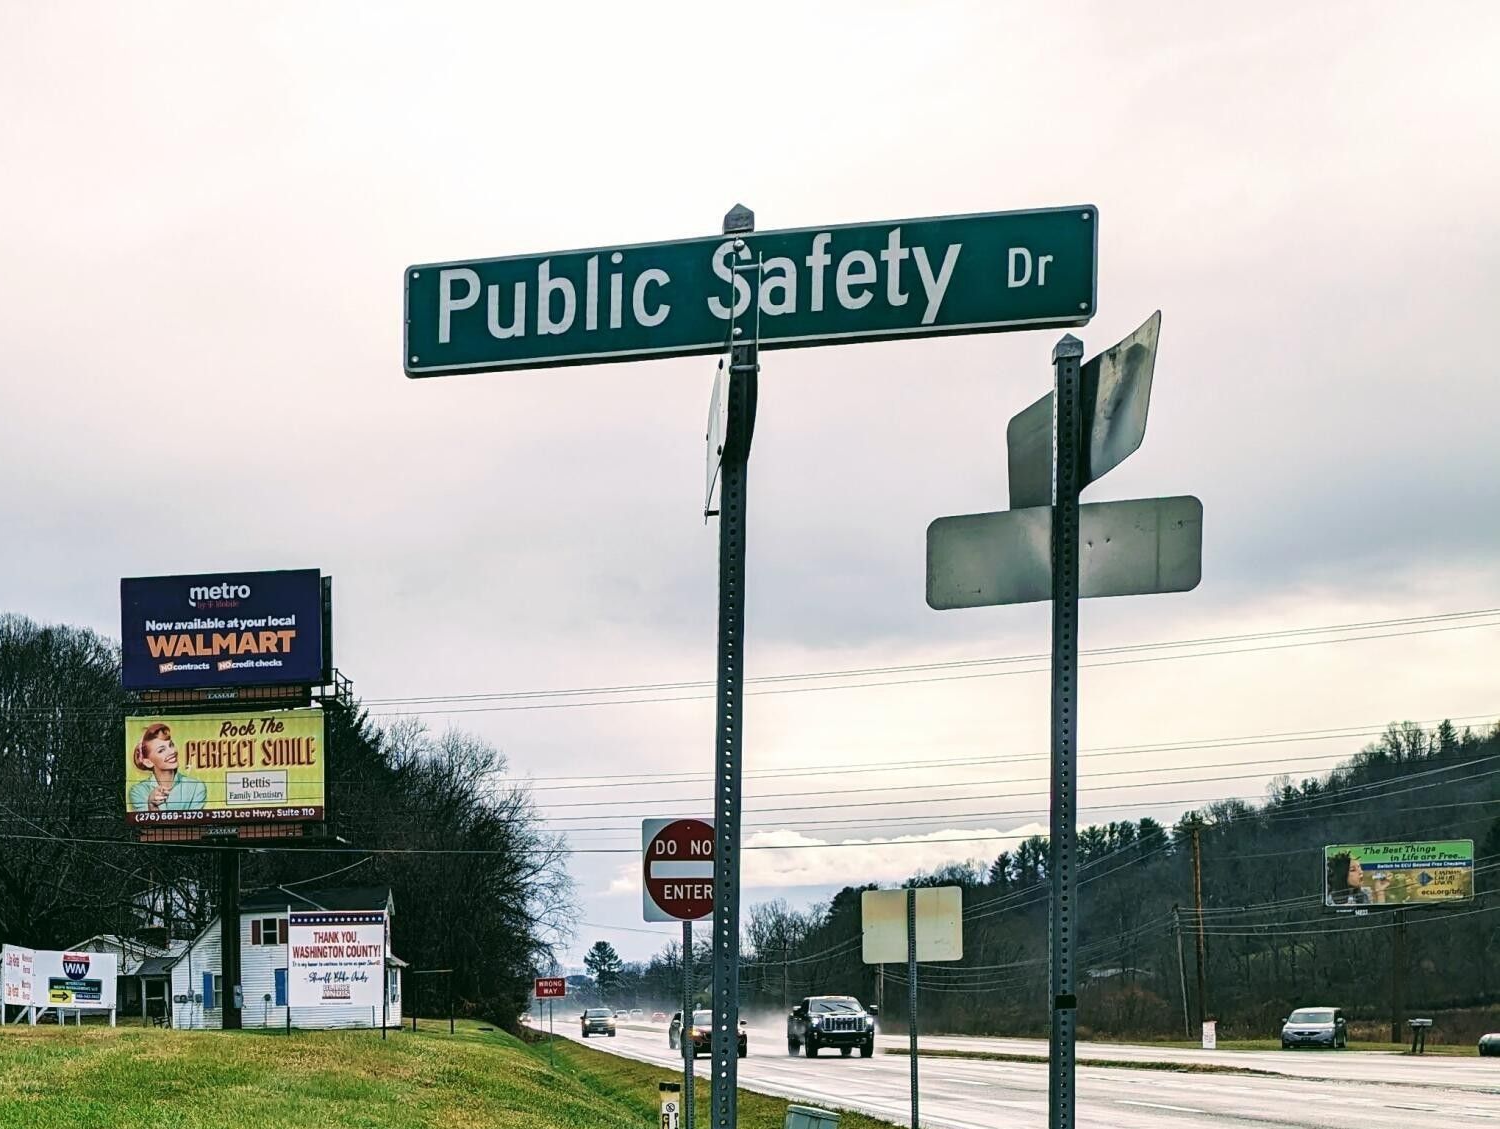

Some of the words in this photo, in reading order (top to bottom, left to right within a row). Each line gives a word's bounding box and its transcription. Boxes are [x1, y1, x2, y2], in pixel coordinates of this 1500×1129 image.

[438, 252, 671, 344] Public
[707, 227, 962, 325] Safety
[1007, 246, 1054, 290] Dr
[190, 582, 251, 600] metro
[145, 620, 172, 632] Now
[175, 617, 225, 630] available
[227, 619, 239, 629] at
[240, 617, 266, 630] your
[268, 614, 296, 627] local
[146, 630, 296, 658] WALMART
[173, 662, 210, 671] contracts
[232, 660, 254, 669] credit
[255, 659, 283, 668] checks
[219, 720, 256, 738] Rock
[259, 717, 285, 734] The
[185, 739, 257, 770] PERFECT
[262, 736, 316, 768] SMILE
[241, 776, 271, 789] Bettis
[229, 790, 251, 802] Family
[253, 788, 284, 800] Dentistry
[135, 812, 160, 822] (276)
[212, 810, 232, 819] 3130
[234, 809, 251, 818] Lee
[277, 807, 299, 817] Suite
[301, 807, 315, 816] 110
[655, 840, 677, 855] DO
[690, 840, 715, 855] NO
[1364, 847, 1380, 855] The
[1382, 846, 1402, 854] Best
[1405, 844, 1436, 853] Things
[1402, 853, 1419, 861] Life
[664, 884, 713, 900] ENTER
[313, 931, 340, 943] THANK
[341, 931, 360, 943] YOU,
[292, 946, 344, 959] WASHINGTON
[346, 945, 381, 958] COUNTY!
[65, 962, 87, 974] WM
[538, 980, 562, 988] WRONG
[543, 987, 558, 995] WAY
